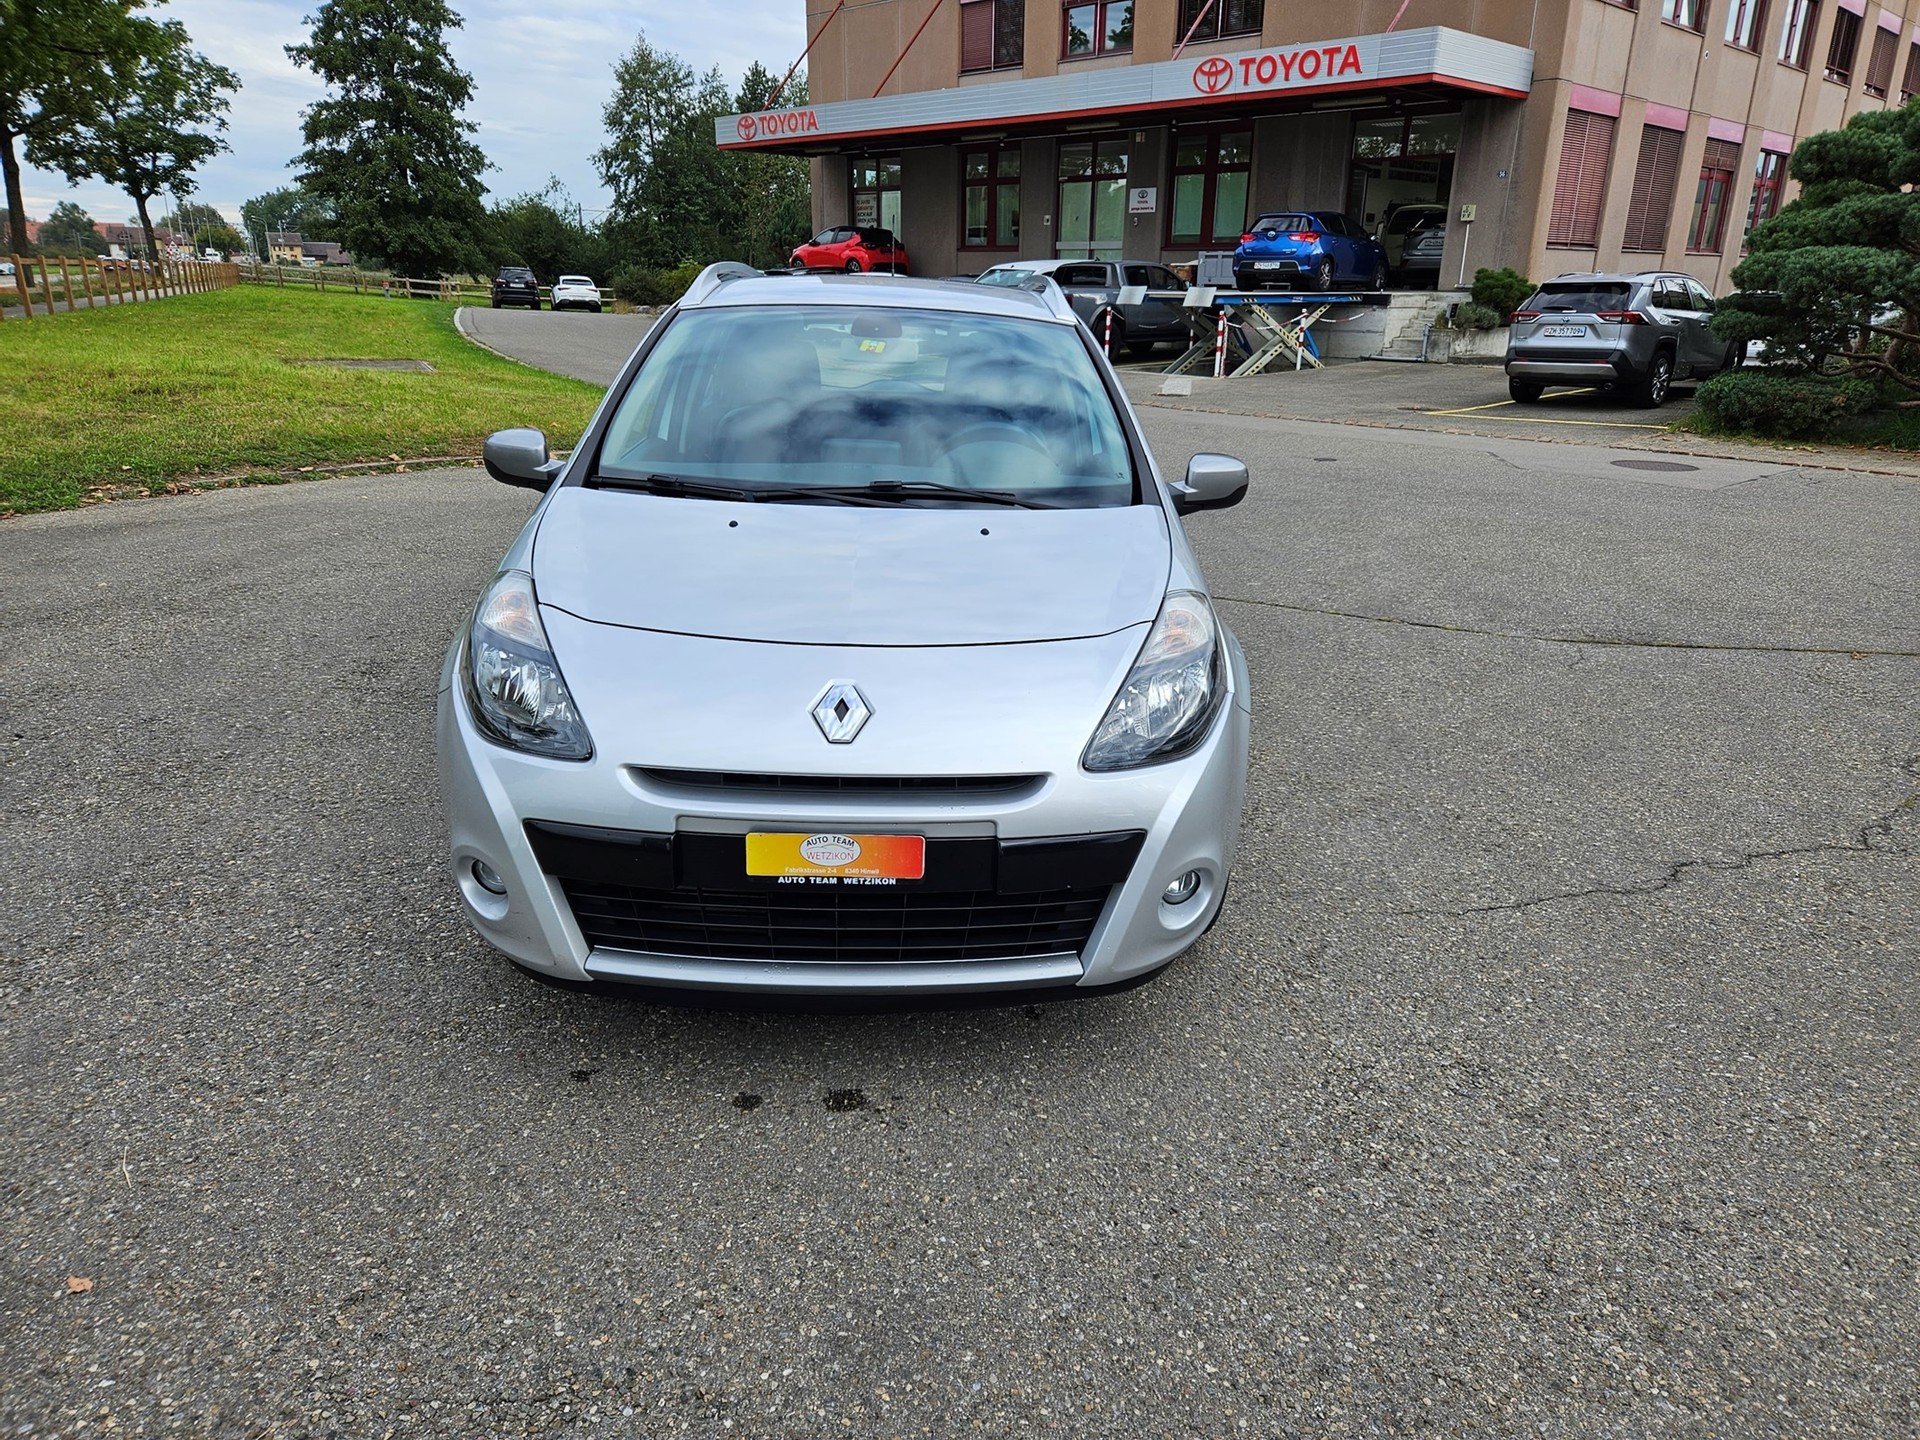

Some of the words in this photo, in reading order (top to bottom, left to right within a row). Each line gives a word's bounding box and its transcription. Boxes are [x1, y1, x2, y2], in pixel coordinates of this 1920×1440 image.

[1239, 45, 1362, 86] TOYOTA
[758, 110, 819, 135] TOYOTA
[806, 836, 829, 847] AUTO
[832, 836, 855, 848] TEAM
[806, 851, 854, 861] WETZIKON
[778, 876, 806, 884] AUTO
[809, 876, 838, 884] TEAM
[843, 877, 896, 885] WETZIKON
